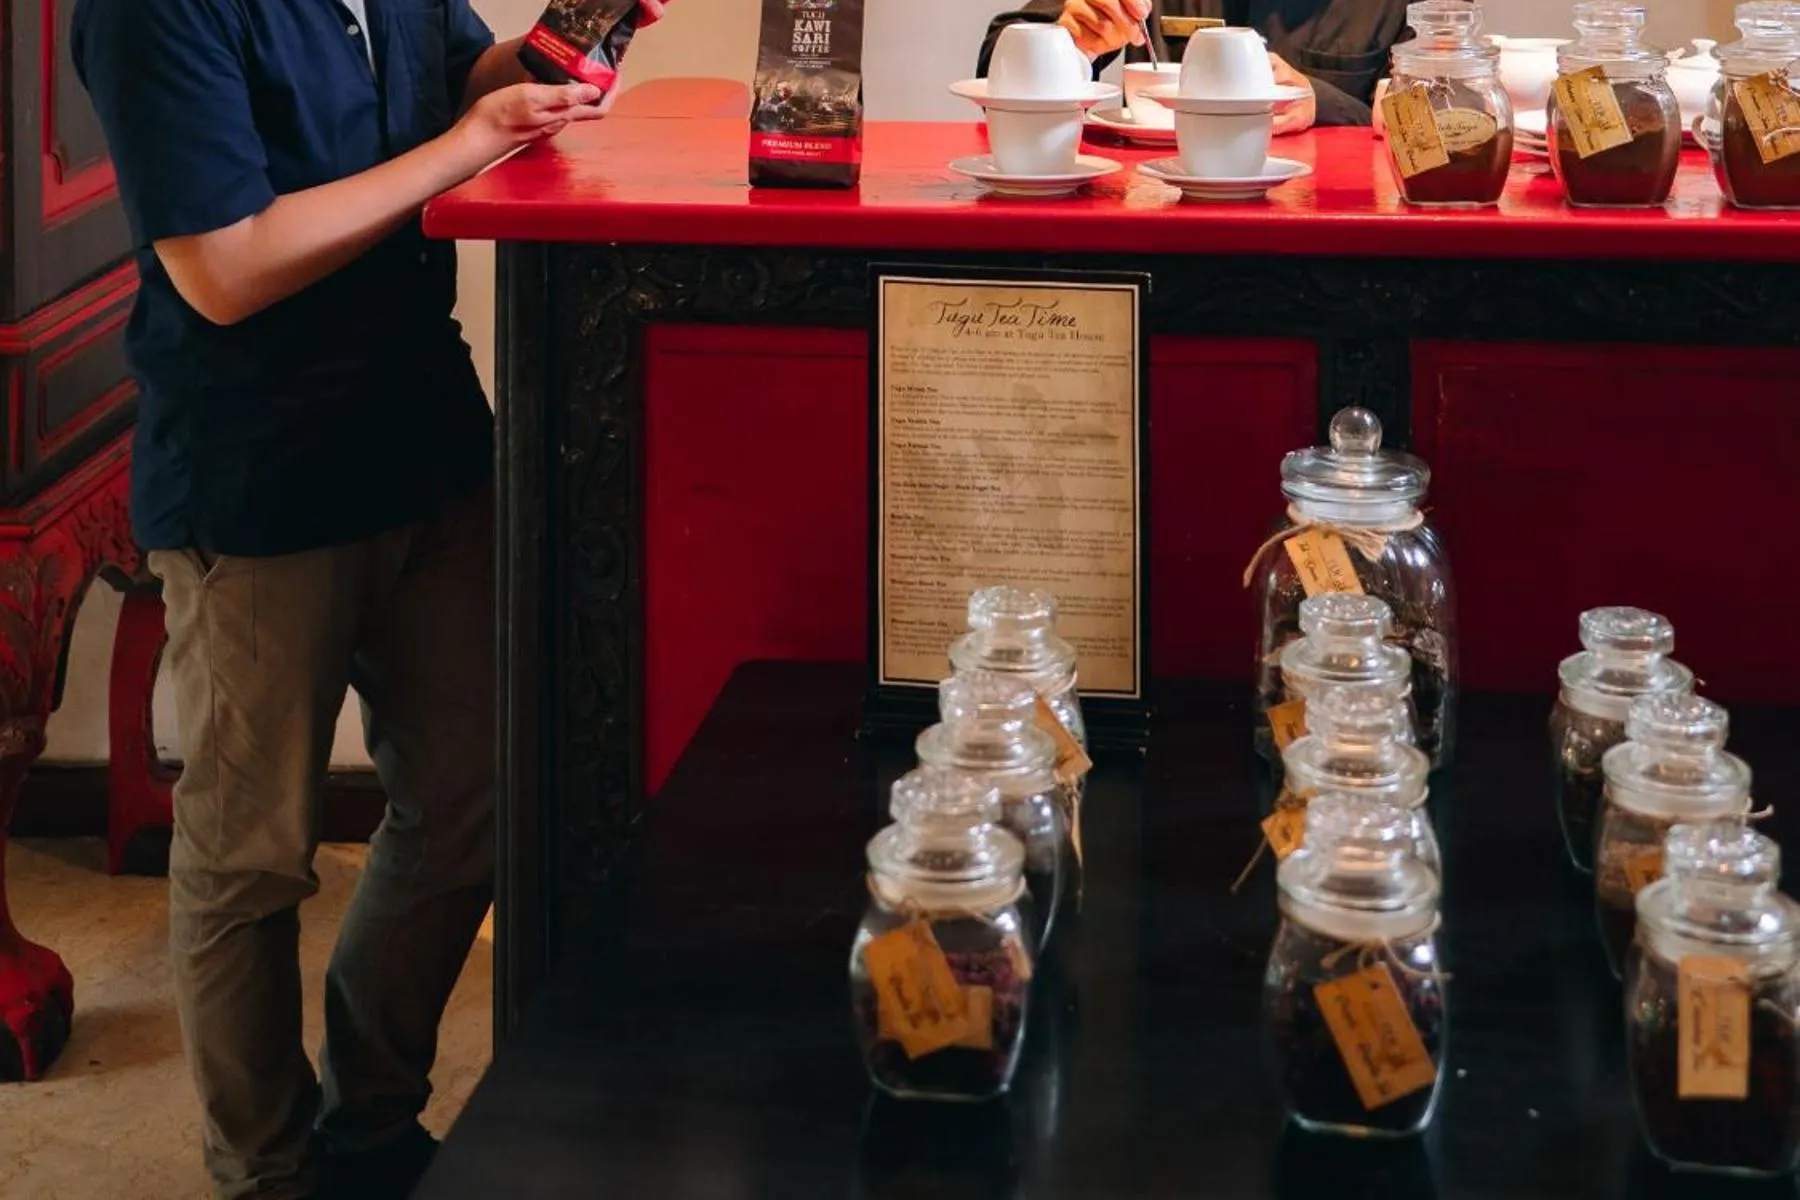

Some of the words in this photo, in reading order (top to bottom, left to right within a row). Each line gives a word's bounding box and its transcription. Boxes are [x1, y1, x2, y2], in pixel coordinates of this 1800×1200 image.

[793, 19, 832, 33] KAWI
[792, 31, 830, 45] SARI
[928, 298, 984, 337] Tugu
[986, 297, 1024, 328] Tea
[1023, 300, 1077, 328] Time
